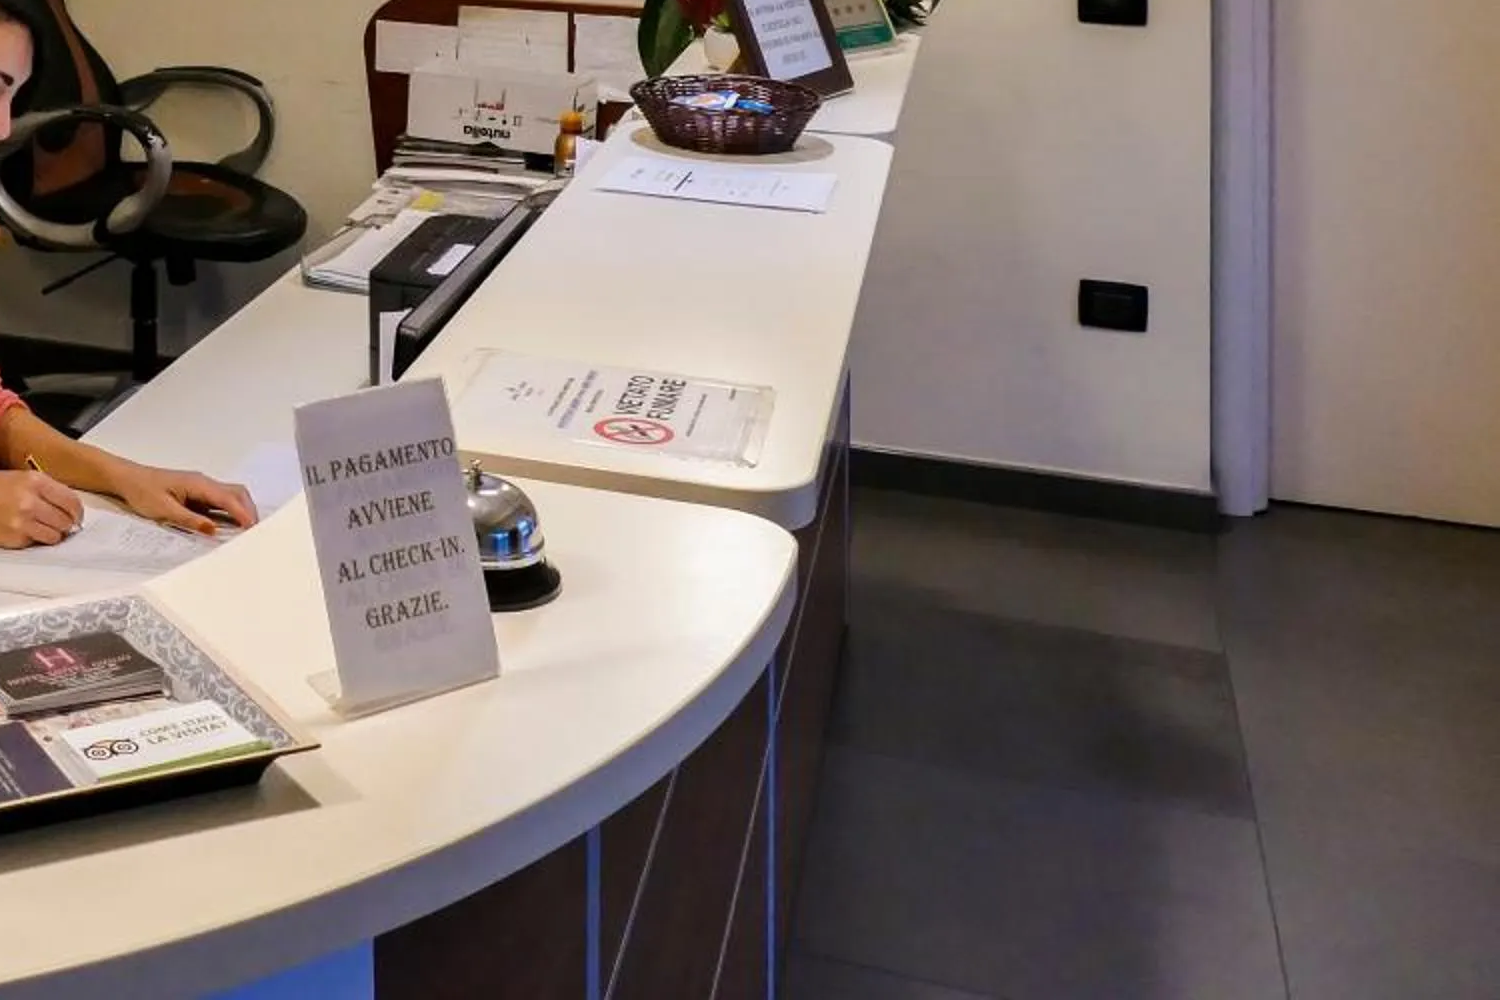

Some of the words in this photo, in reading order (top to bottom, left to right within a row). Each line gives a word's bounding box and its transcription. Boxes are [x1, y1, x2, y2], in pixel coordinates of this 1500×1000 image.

[305, 466, 325, 487] IL
[331, 437, 454, 482] PAGAMENTO
[347, 490, 435, 530] AVVIENE
[338, 560, 364, 584] AL
[369, 535, 465, 575] CHECK-IN.
[365, 591, 449, 629] GRAZIE.
